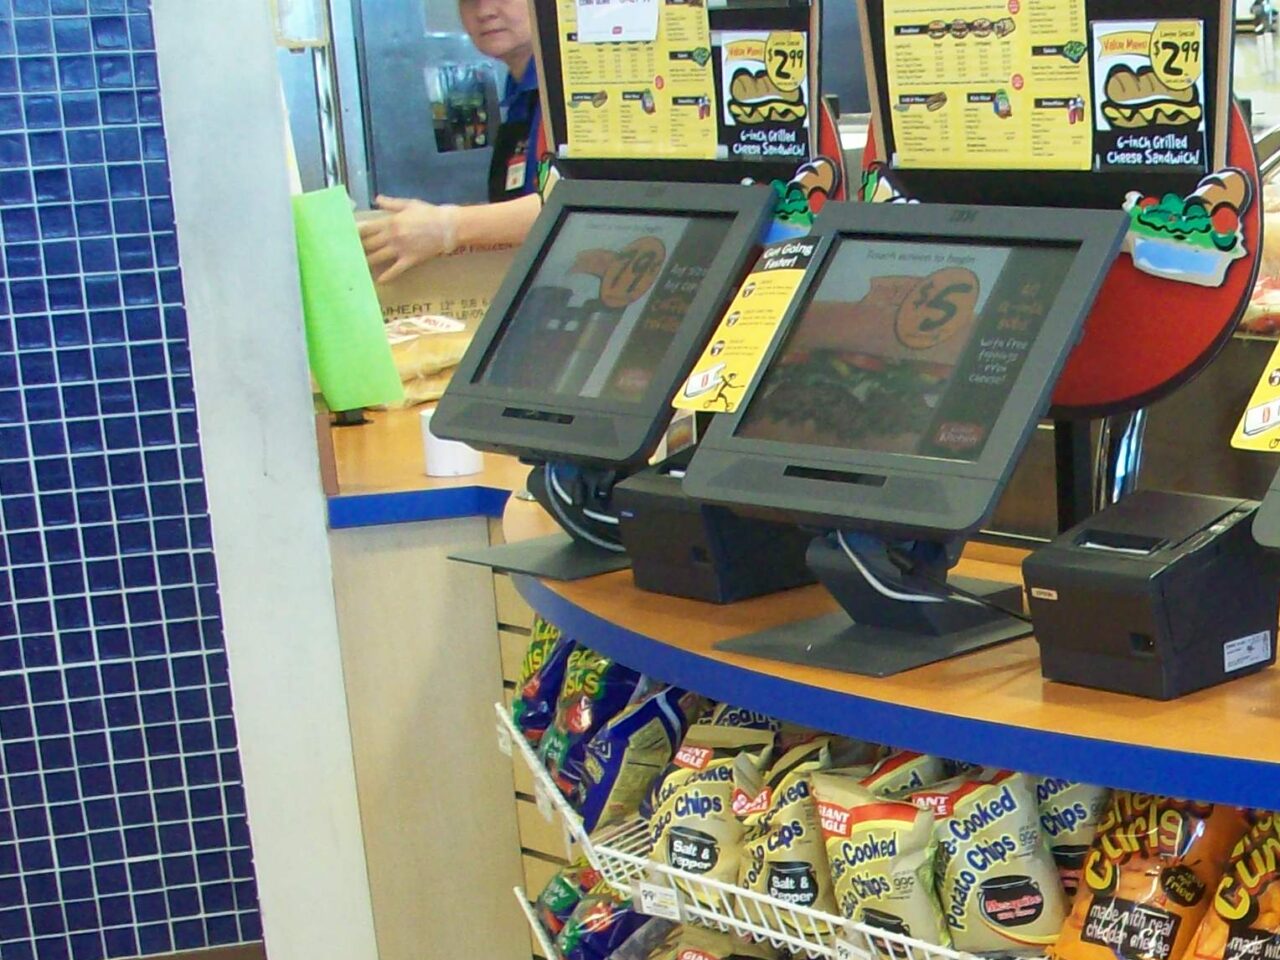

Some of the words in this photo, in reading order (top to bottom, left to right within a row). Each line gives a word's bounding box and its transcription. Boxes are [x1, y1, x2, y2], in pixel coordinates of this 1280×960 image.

[1153, 134, 1188, 149] Grilled
[1107, 151, 1142, 163] Cheese
[782, 242, 814, 256] Going
[675, 793, 722, 818] Chips
[1040, 802, 1088, 836] Chips
[672, 839, 699, 856] Salt
[966, 833, 1017, 872] Chips
[1084, 807, 1184, 889] Curls
[852, 875, 890, 902] Chips
[1149, 917, 1173, 937] real
[1228, 936, 1263, 956] made
